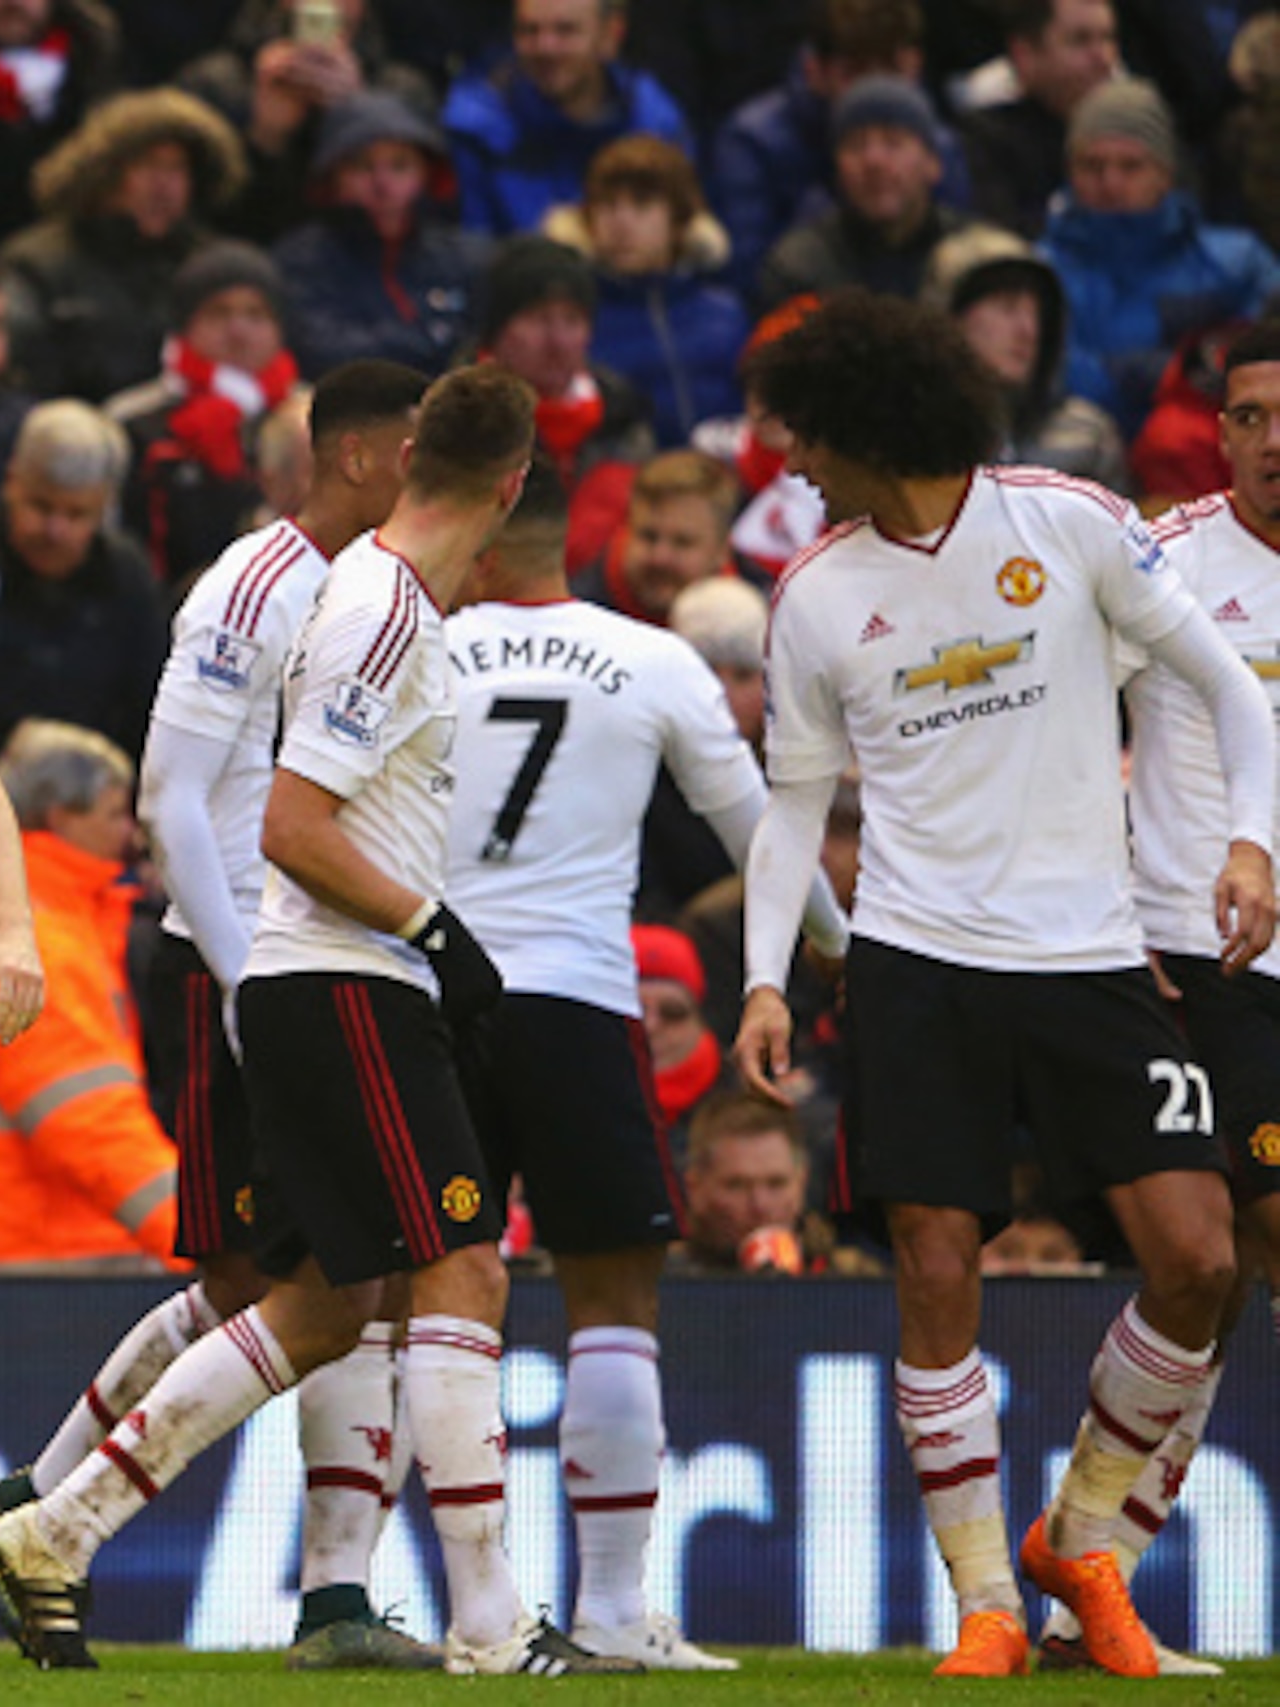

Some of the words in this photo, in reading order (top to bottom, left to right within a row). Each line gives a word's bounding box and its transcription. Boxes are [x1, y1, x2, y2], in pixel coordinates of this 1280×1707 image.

[898, 683, 1047, 738] CHEVROLET
[479, 696, 570, 863] 7
[1145, 1058, 1214, 1136] 21
[184, 1346, 1275, 1660] Airln
